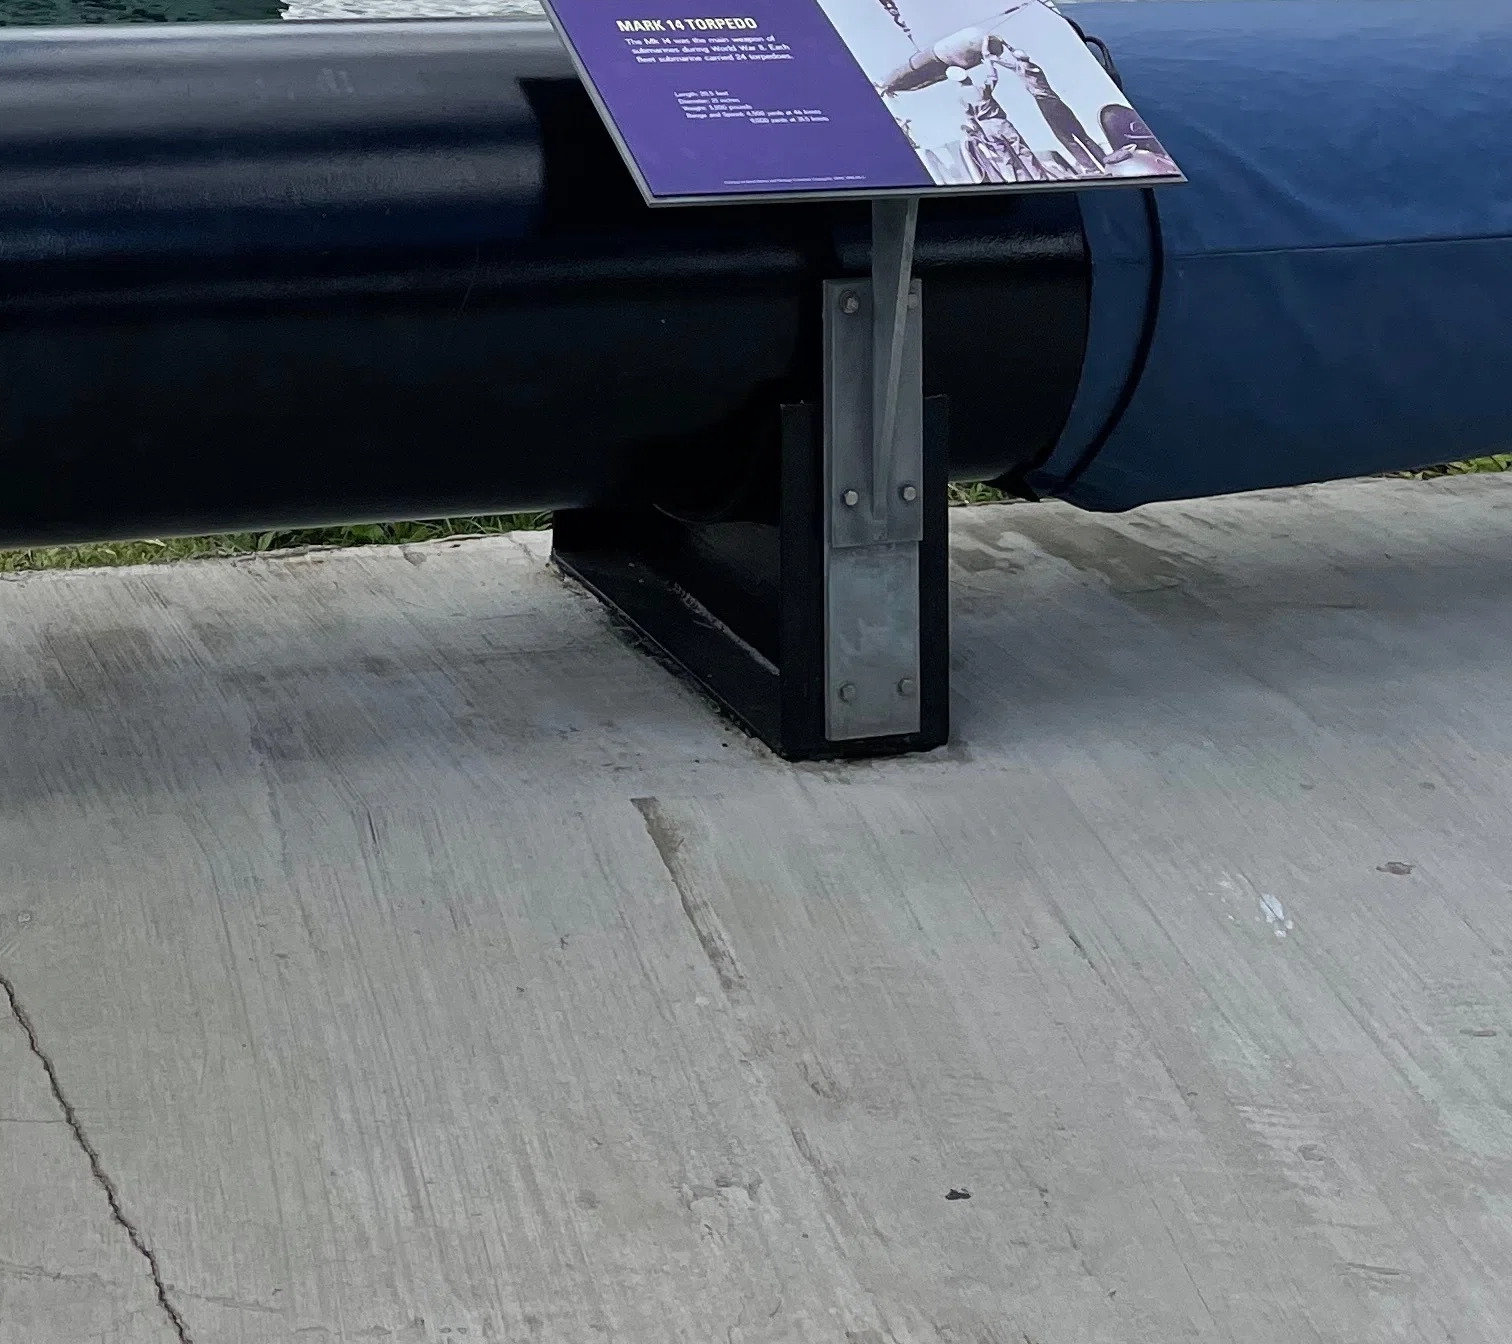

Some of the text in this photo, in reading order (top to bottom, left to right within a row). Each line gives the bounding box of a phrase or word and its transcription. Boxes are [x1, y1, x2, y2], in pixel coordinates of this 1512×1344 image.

[616, 17, 758, 32] MARK 14 TORPEDO
[625, 37, 642, 46] The
[692, 36, 706, 44] the
[766, 34, 776, 42] of
[682, 45, 710, 54] during
[711, 44, 737, 52] World
[739, 44, 756, 52] War
[768, 43, 791, 51] Each
[704, 53, 734, 62] carried
[736, 53, 747, 61] 24
